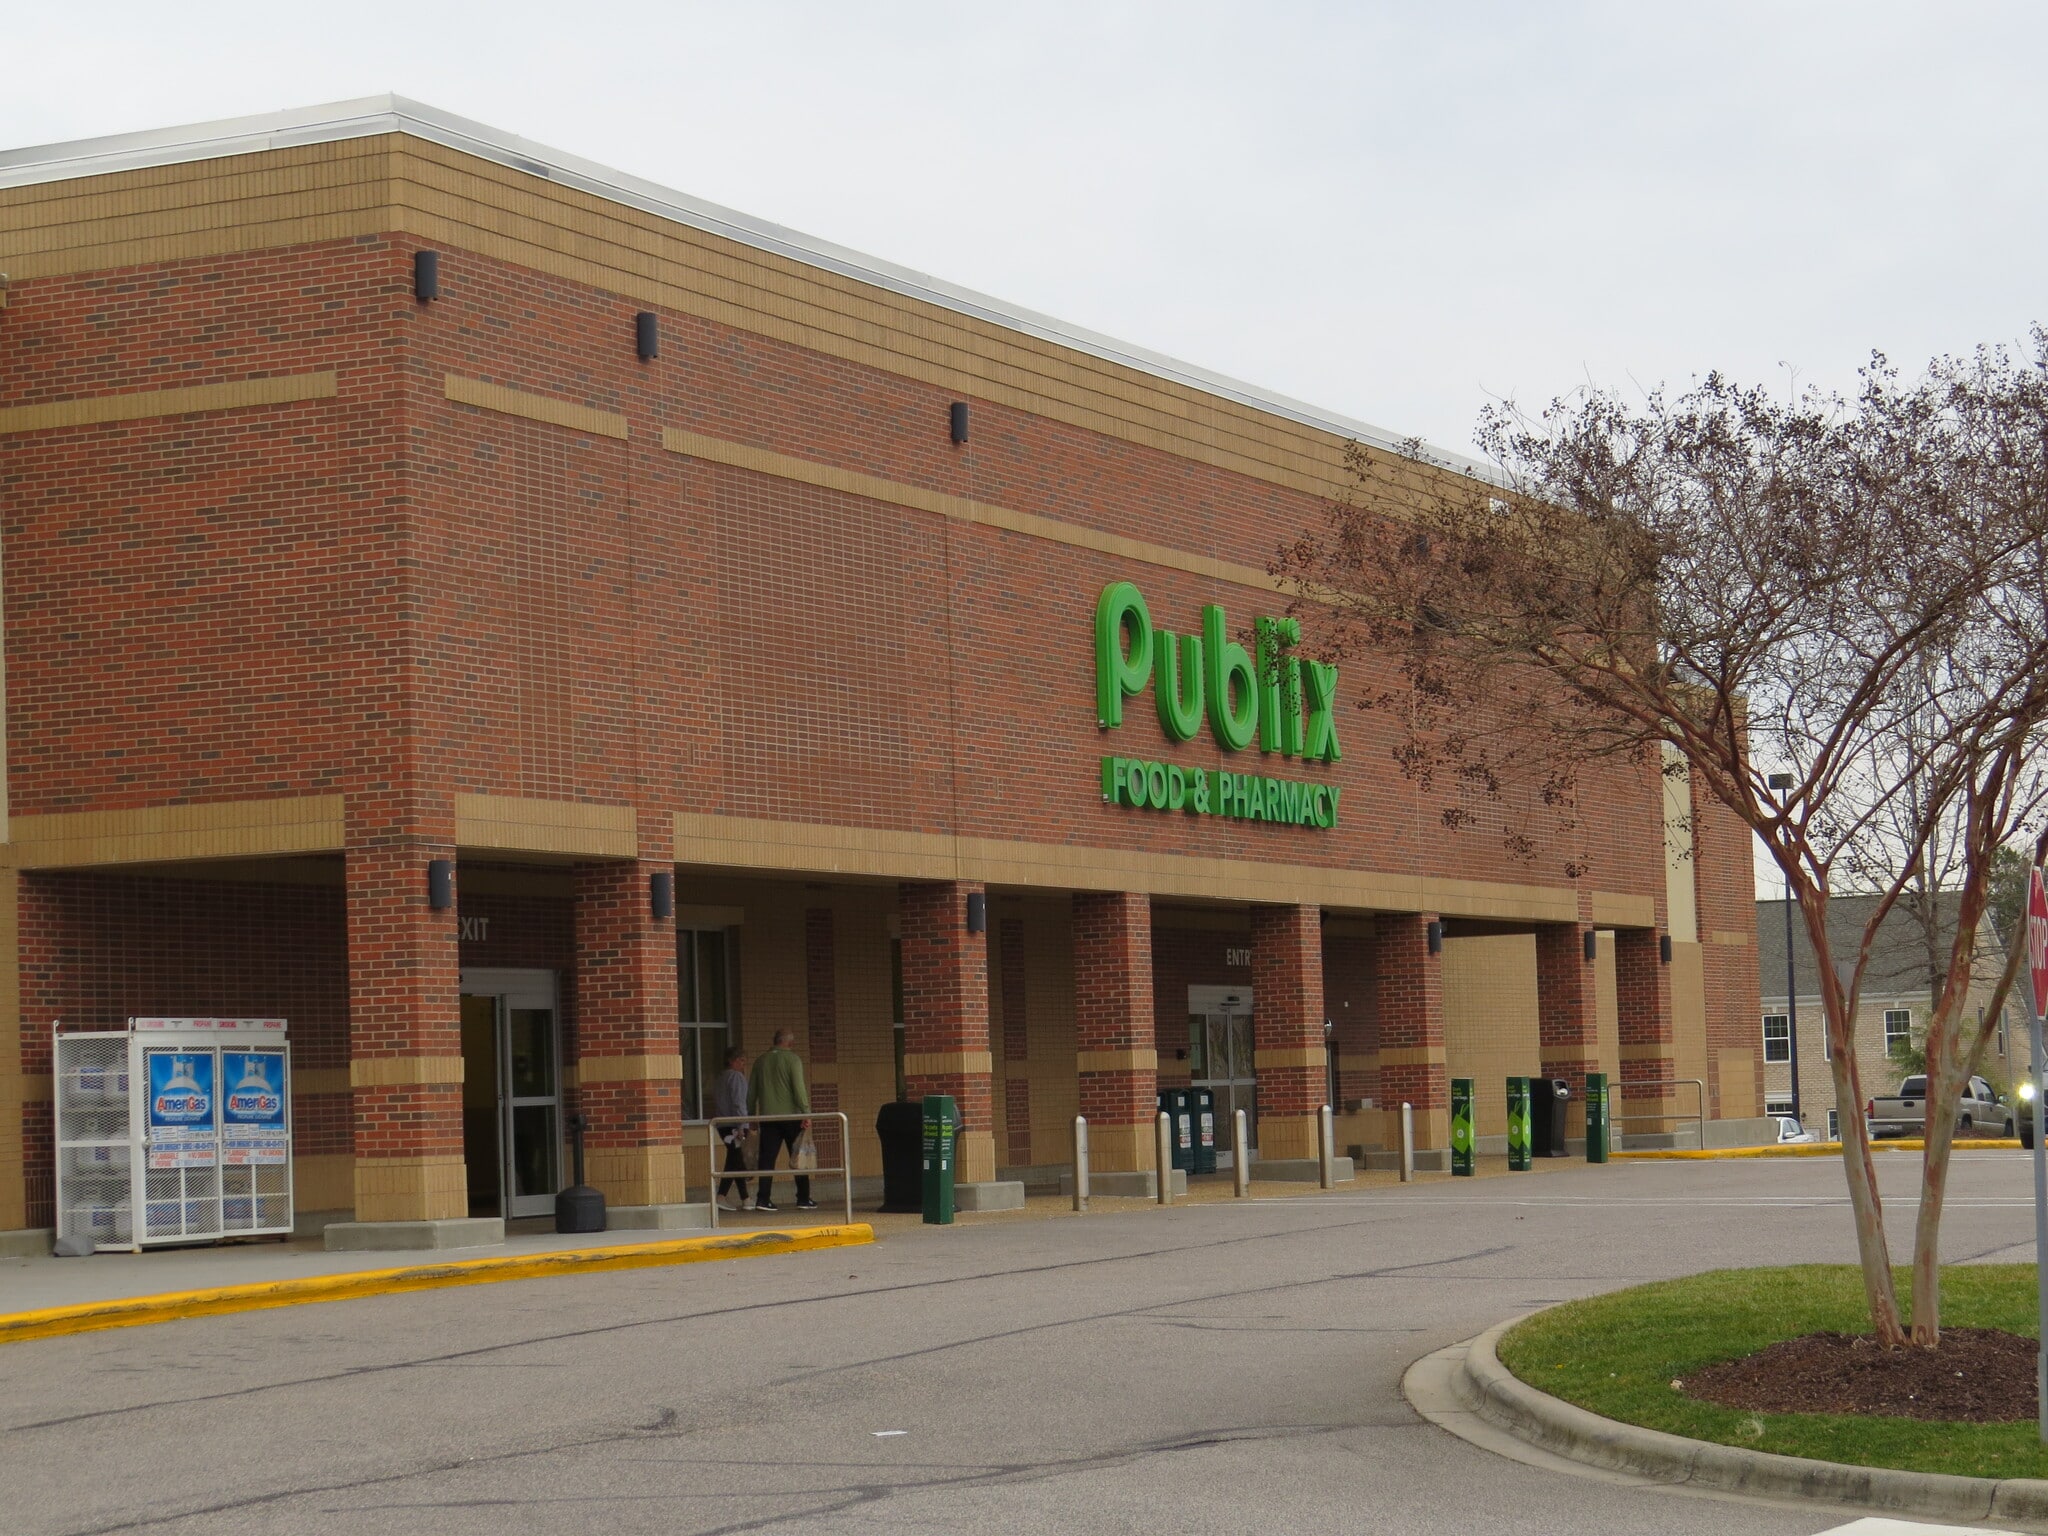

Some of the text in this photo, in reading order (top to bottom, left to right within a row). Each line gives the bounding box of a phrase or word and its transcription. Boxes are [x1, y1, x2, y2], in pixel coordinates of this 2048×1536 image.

[1095, 581, 1342, 762] Publix
[1101, 757, 1341, 828] FOOD & PHARMACY
[458, 916, 489, 941] XIT
[2030, 915, 2048, 970] STOP
[157, 1096, 206, 1112] AmeriGas
[230, 1095, 277, 1110] AmeriGas
